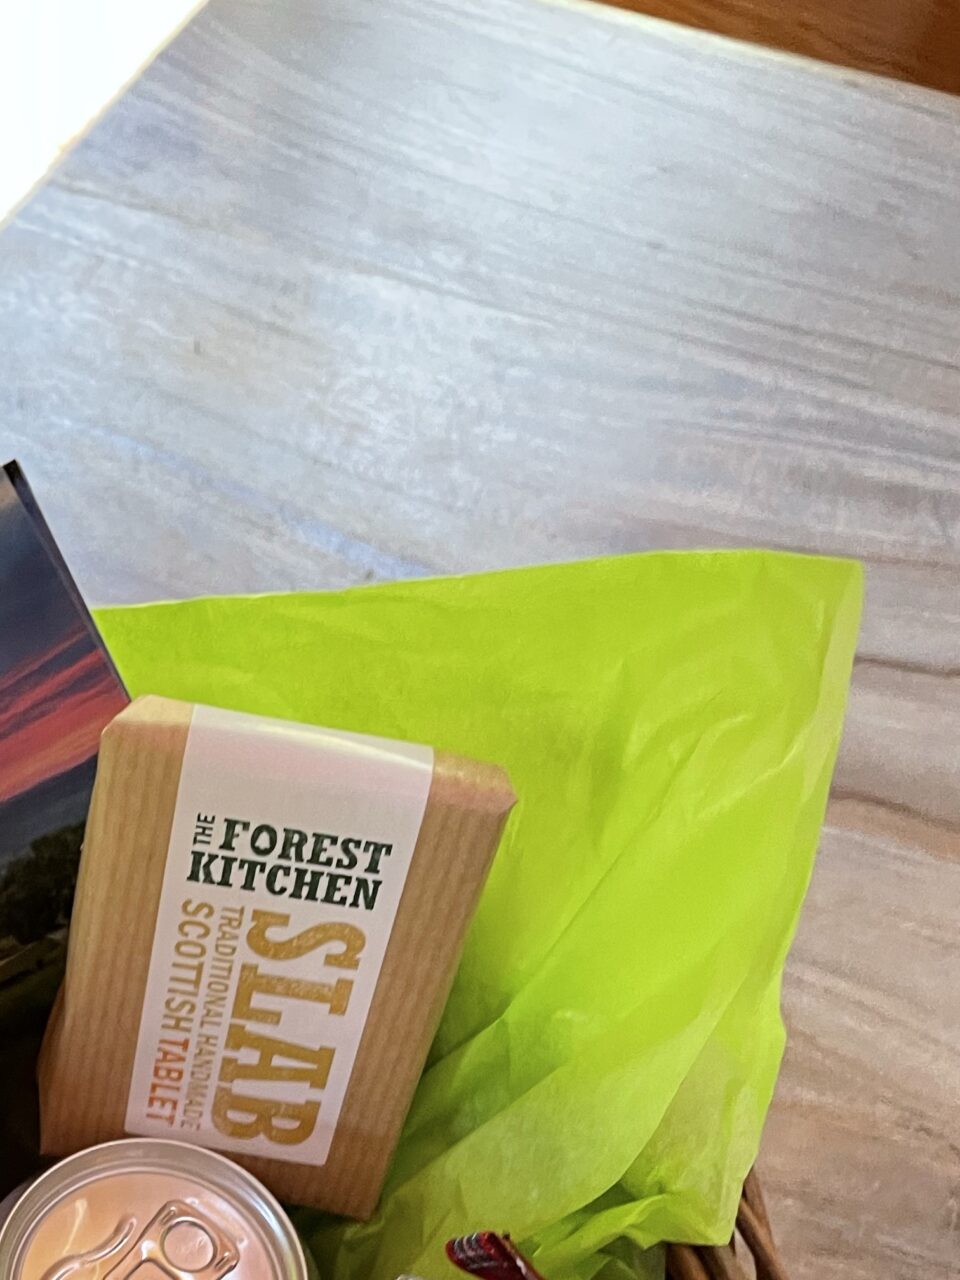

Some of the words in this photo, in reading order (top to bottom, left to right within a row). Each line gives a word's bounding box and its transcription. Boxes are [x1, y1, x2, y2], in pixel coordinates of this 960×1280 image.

[186, 850, 383, 911] KITCHEN
[193, 812, 216, 847] THE
[218, 817, 393, 875] FOREST
[160, 897, 215, 1034] SCOTTISH
[197, 904, 246, 1030] TRADITIONAL
[210, 908, 367, 1146] SLAB
[145, 1037, 191, 1129] TABLET
[180, 1032, 220, 1131] HANDMADE
